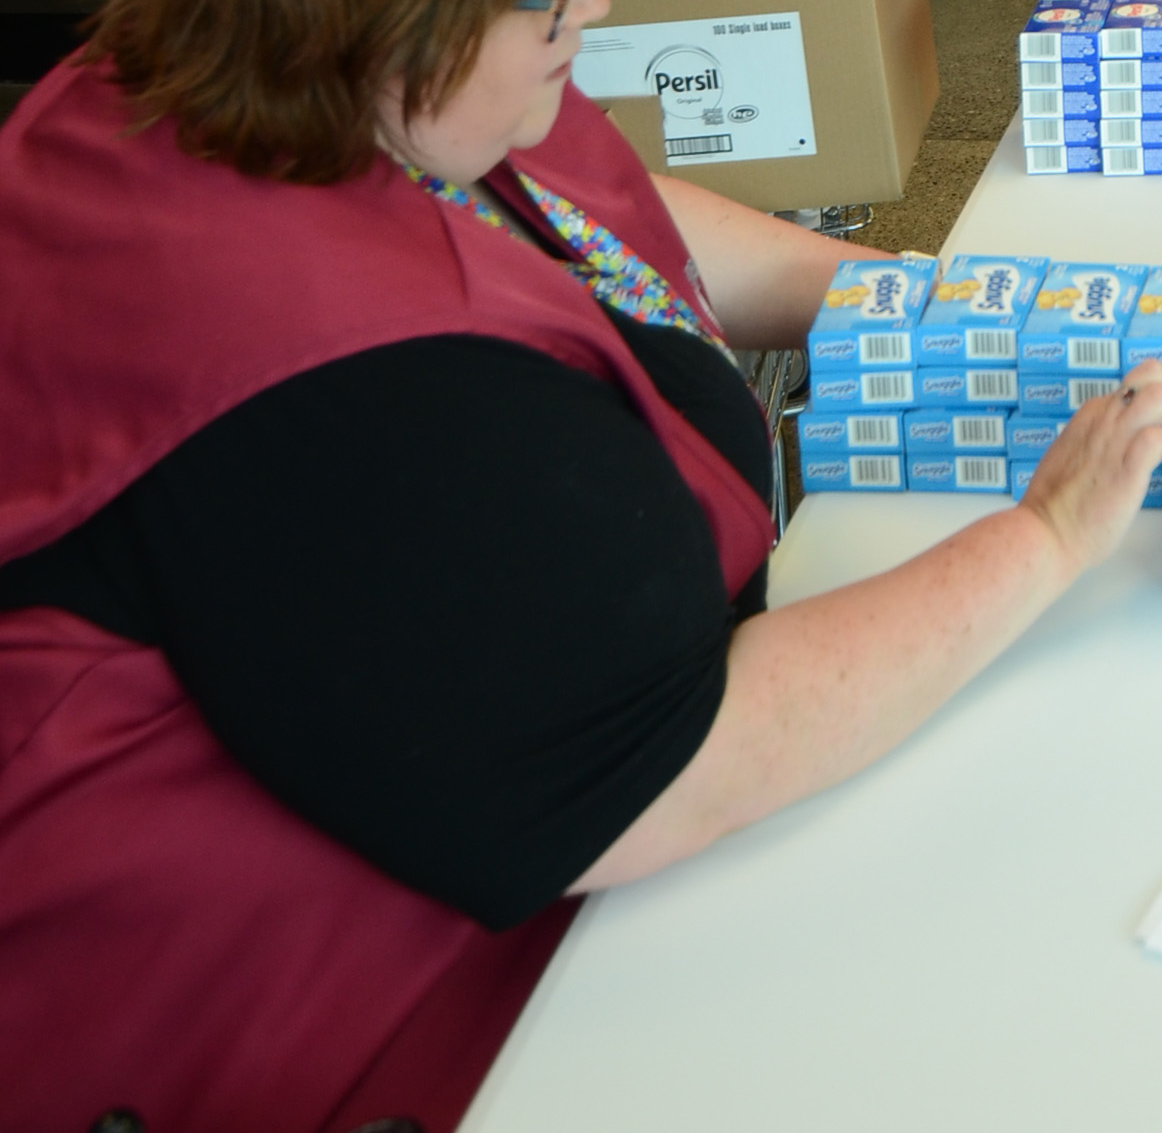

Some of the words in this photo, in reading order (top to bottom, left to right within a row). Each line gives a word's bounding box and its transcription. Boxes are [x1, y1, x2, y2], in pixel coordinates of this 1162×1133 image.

[655, 68, 719, 95] Persil
[868, 273, 902, 315] Snuggle
[977, 268, 1014, 310] Snuggle
[1078, 276, 1112, 320] Snuggle
